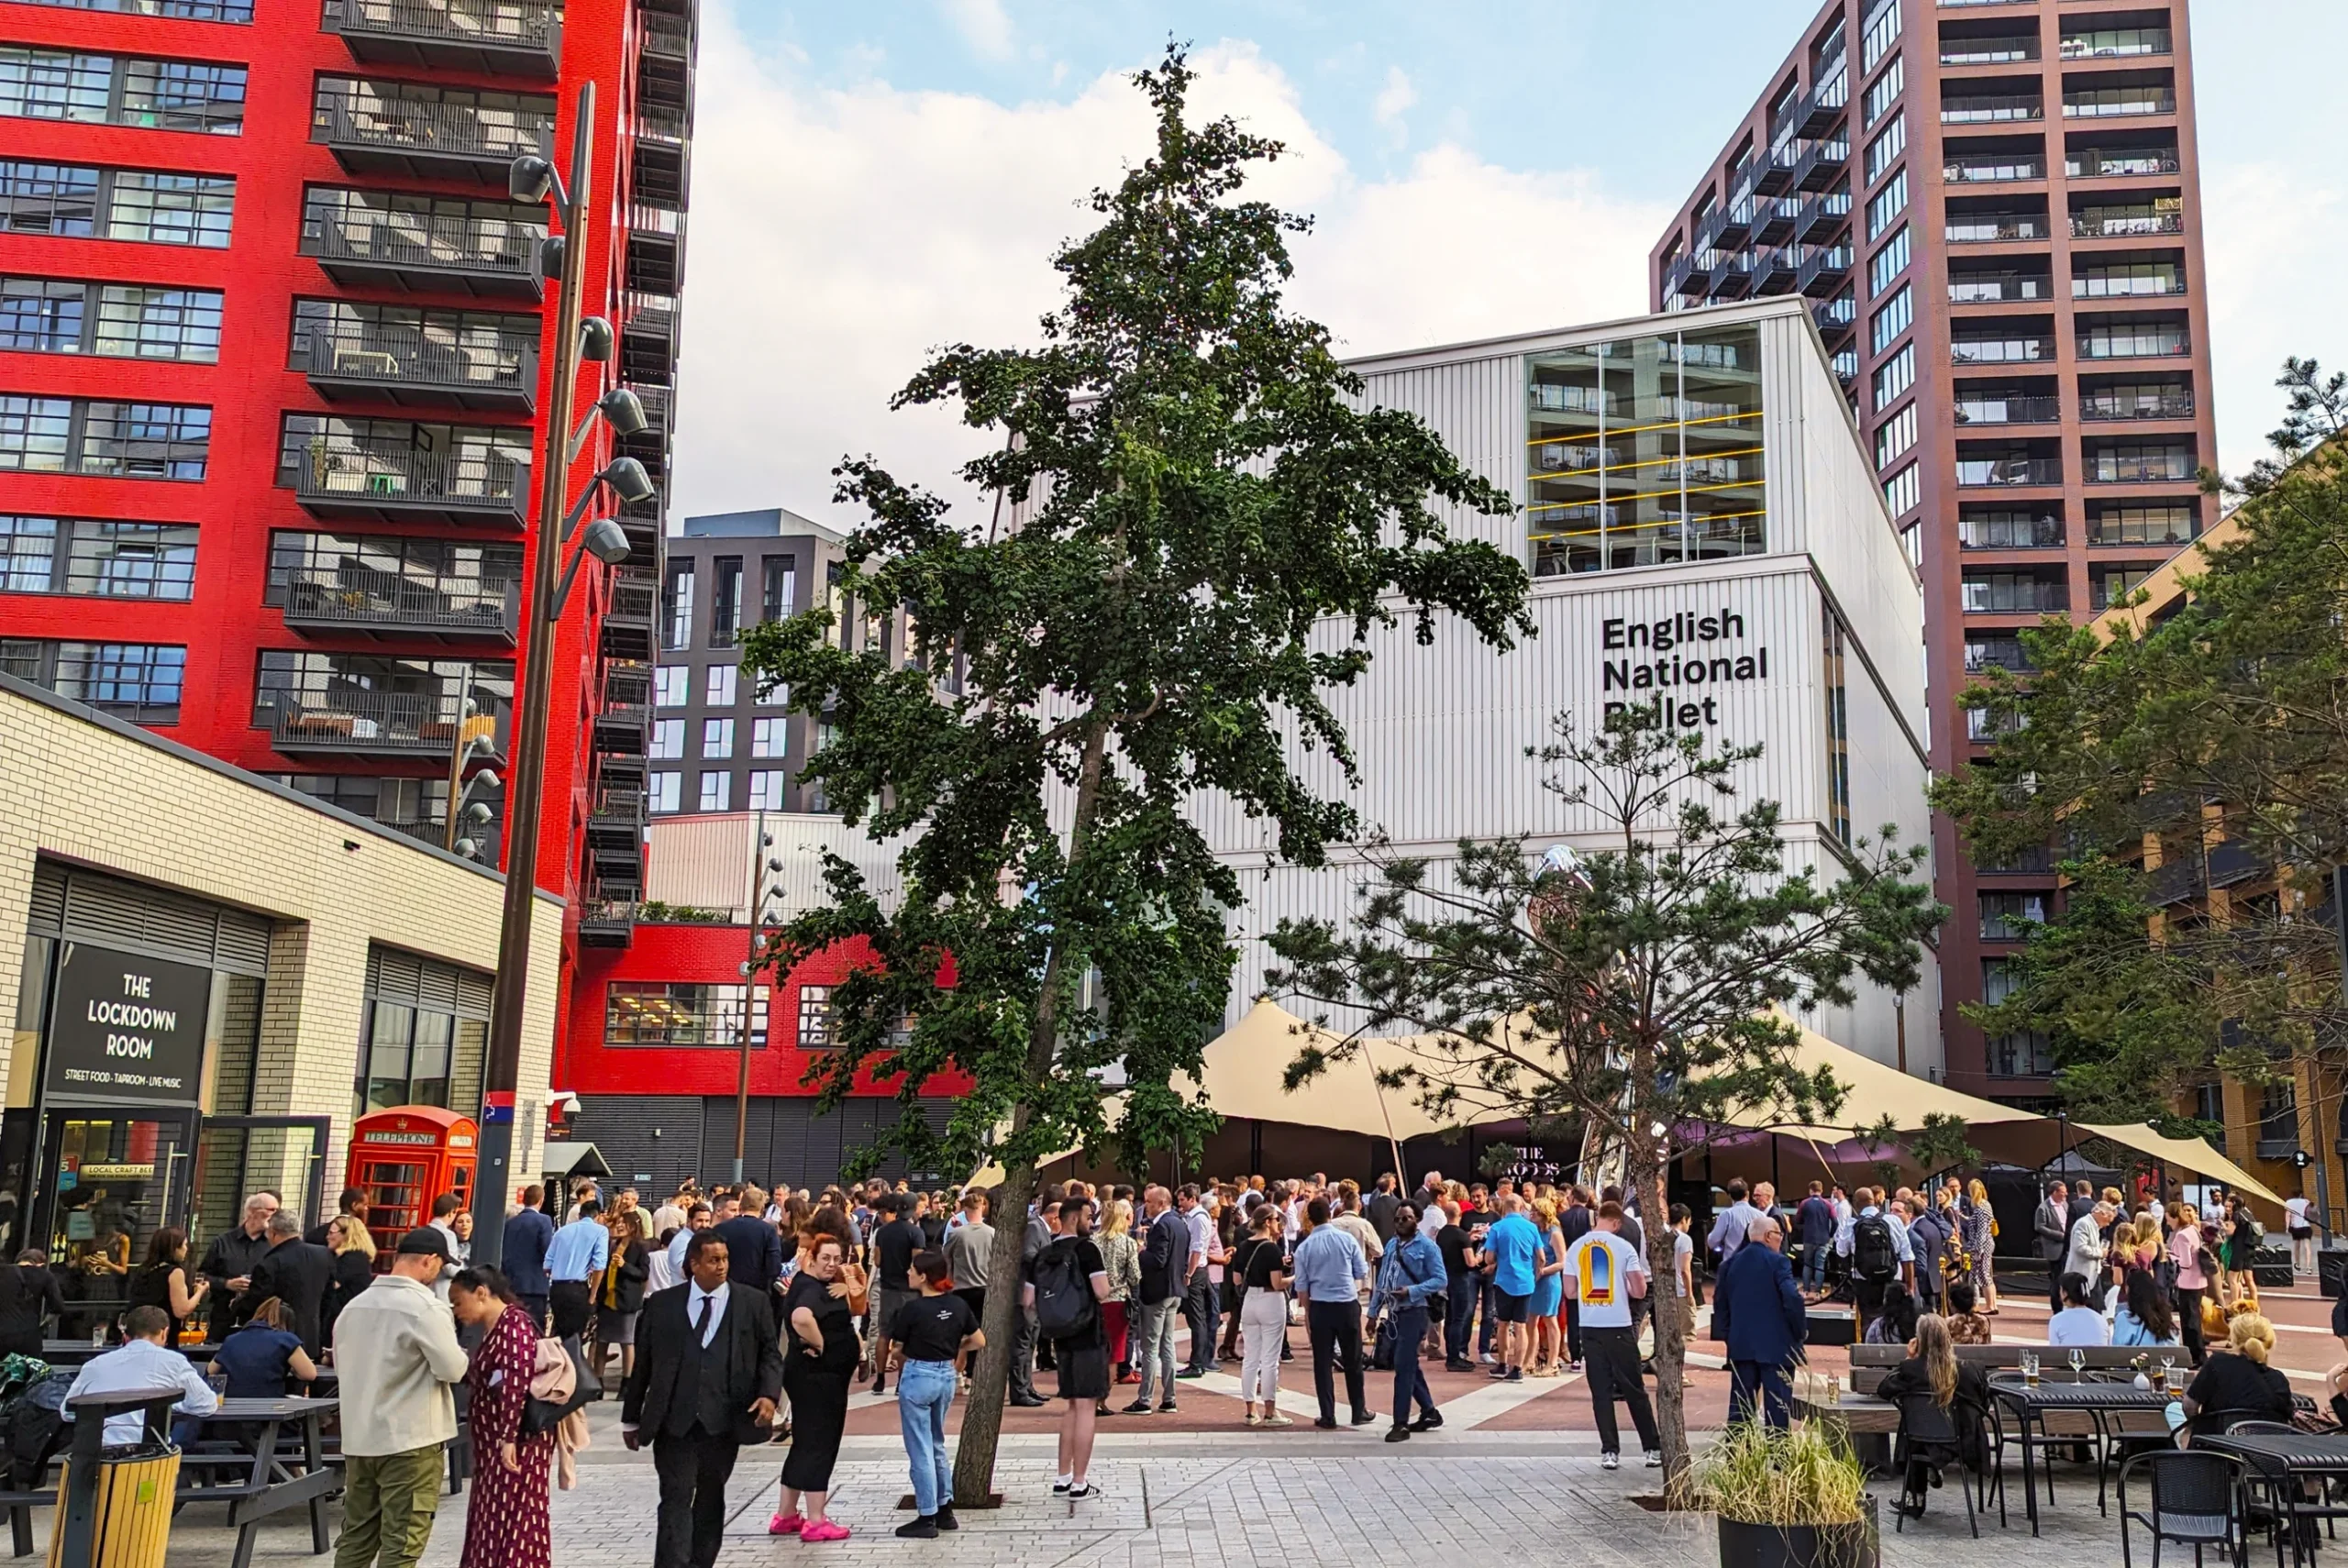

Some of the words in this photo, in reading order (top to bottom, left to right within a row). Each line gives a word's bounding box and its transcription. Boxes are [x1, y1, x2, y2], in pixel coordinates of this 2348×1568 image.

[1603, 608, 1744, 651] English
[1603, 646, 1767, 690] National
[123, 973, 151, 999] THE
[87, 999, 176, 1032] LOCKDOWN
[106, 1033, 153, 1059] ROOM
[65, 1068, 90, 1081] STREET
[90, 1071, 111, 1083] FOOD
[115, 1073, 146, 1086] TAPROOM
[149, 1077, 162, 1088] LIVE
[162, 1078, 182, 1088] MUSIC
[368, 1132, 435, 1143] TELEPHONE
